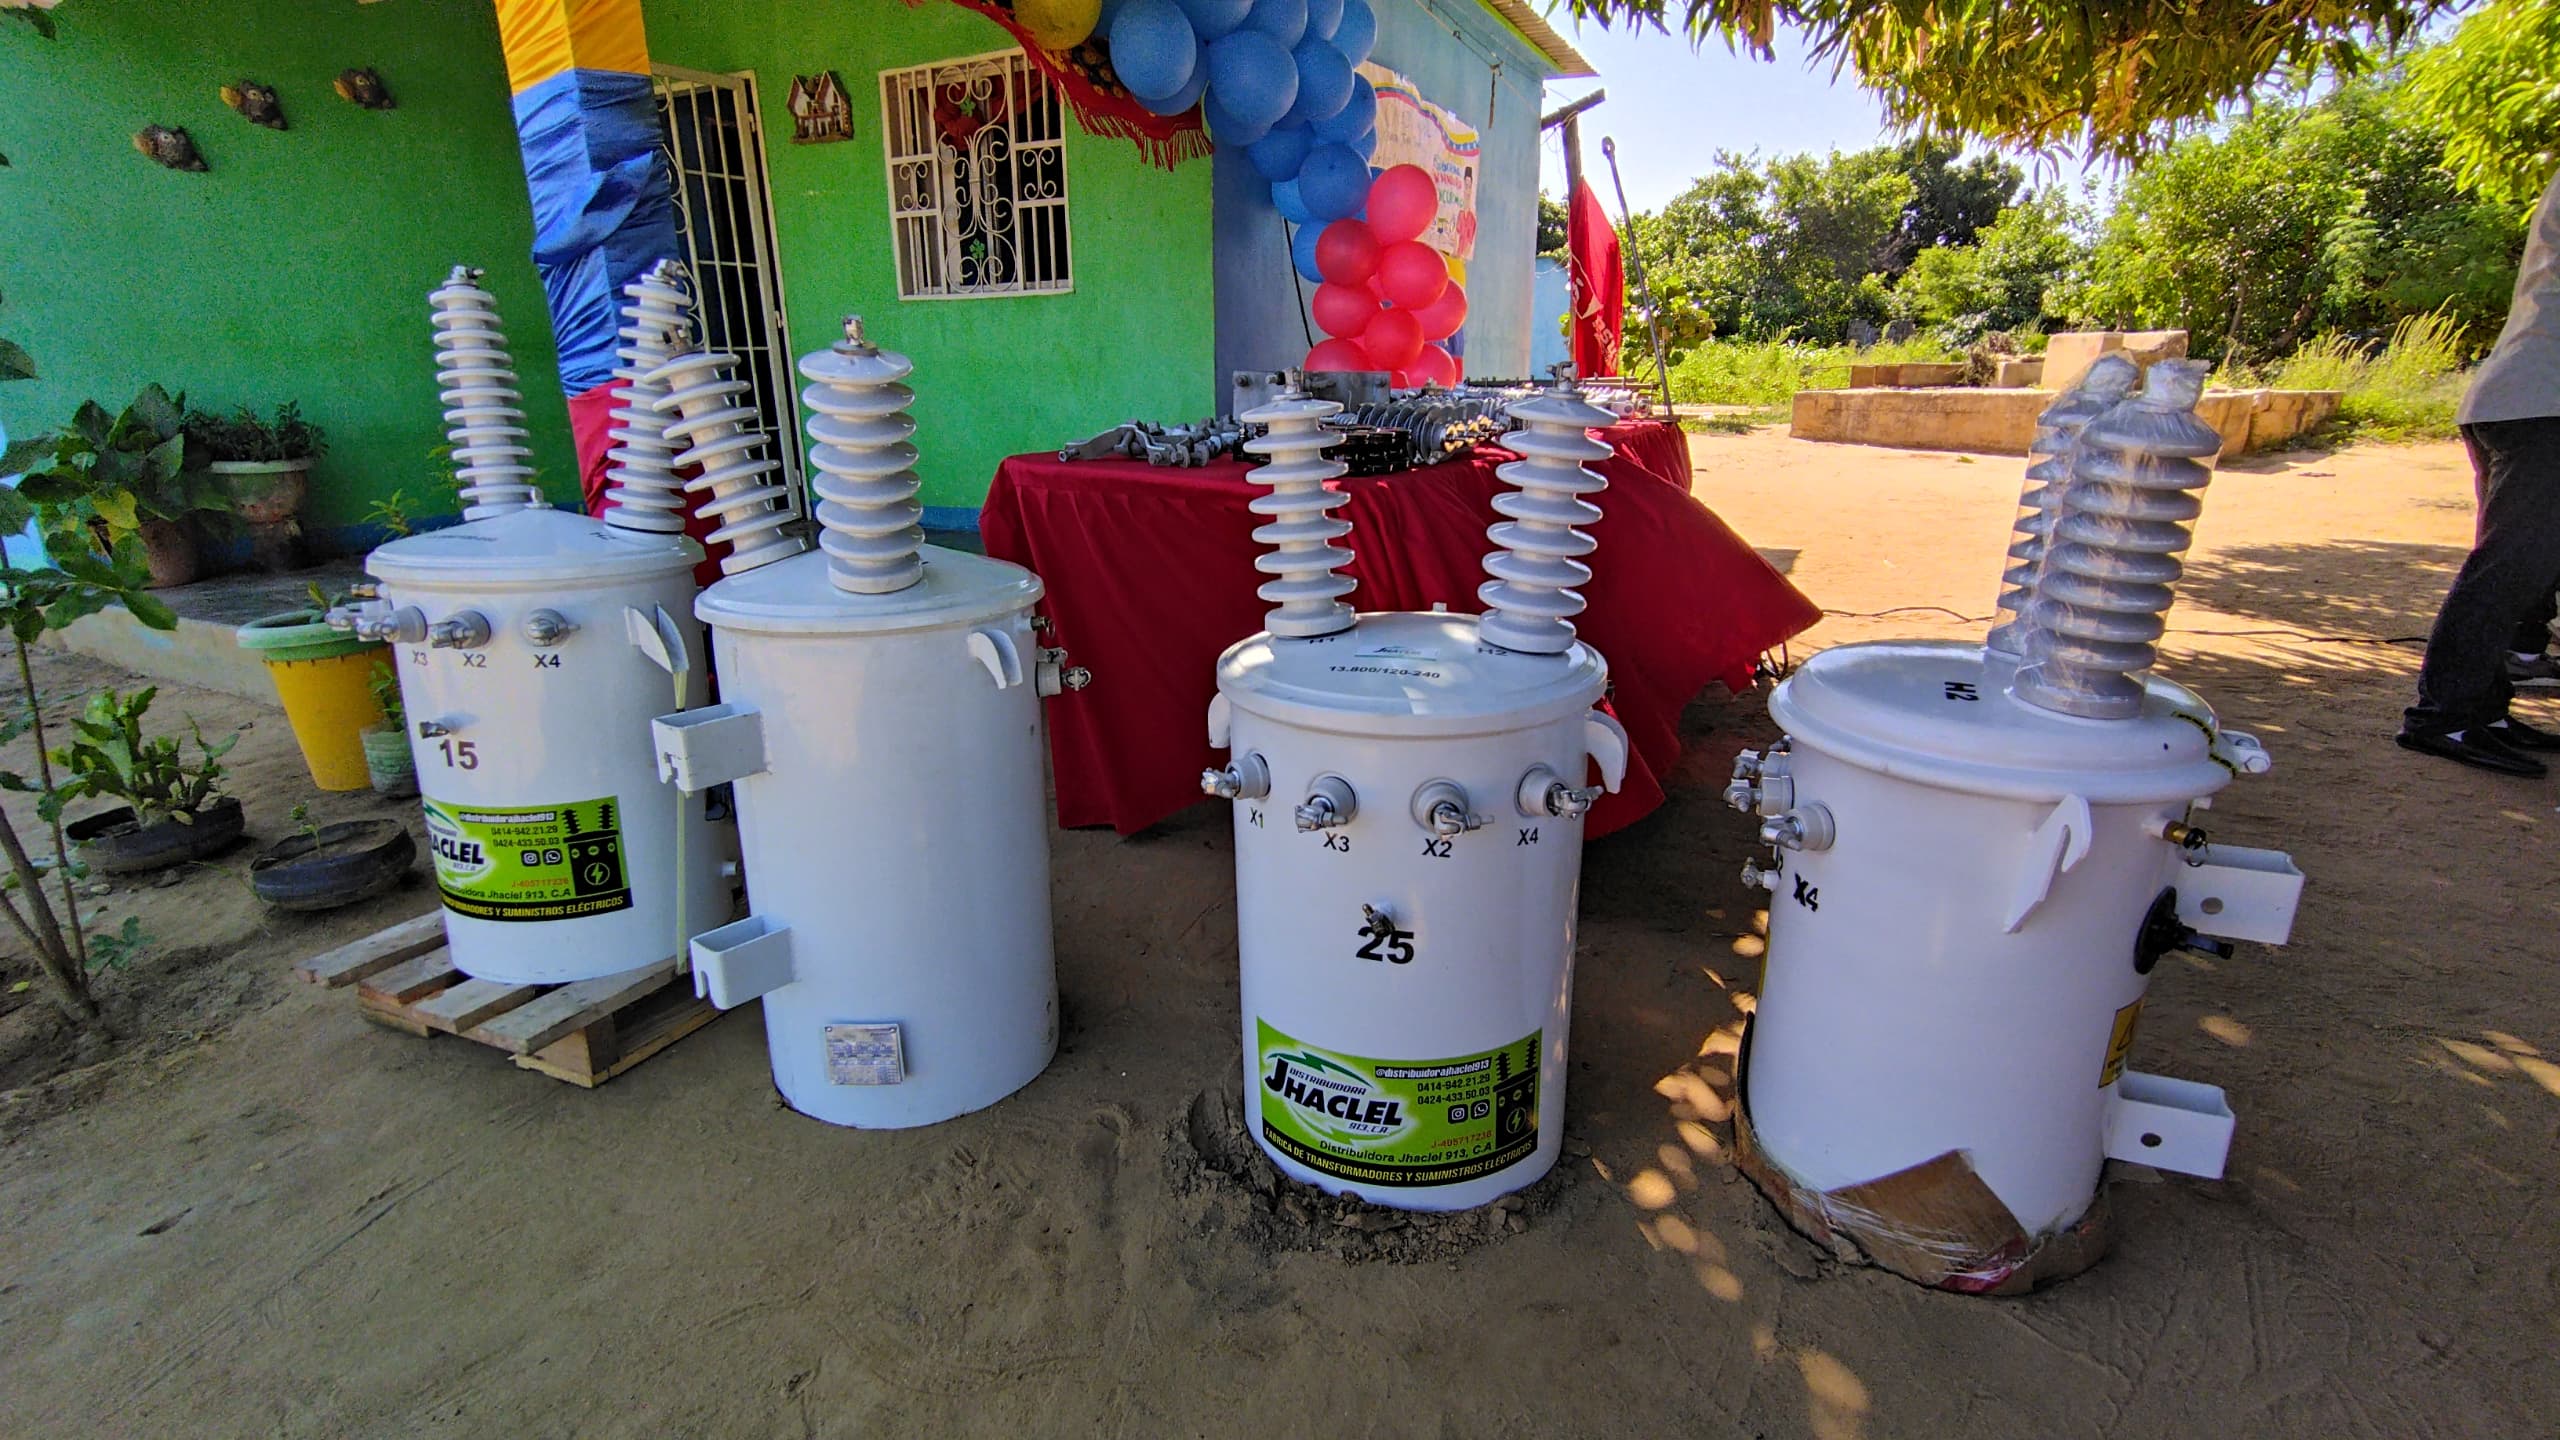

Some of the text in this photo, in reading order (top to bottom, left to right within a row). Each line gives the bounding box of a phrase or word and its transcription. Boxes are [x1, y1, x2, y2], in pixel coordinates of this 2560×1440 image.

[412, 650, 428, 666] X3
[463, 652, 487, 668] X2
[534, 653, 561, 668] X4
[1944, 681, 1979, 701] H2
[439, 739, 479, 770] 15
[1250, 807, 1264, 828] X1
[1323, 831, 1350, 852] X3
[1517, 828, 1539, 846] X4
[431, 834, 484, 865] ACLEL
[1422, 838, 1452, 858] X2
[496, 907, 501, 916] Y
[502, 904, 564, 917] SUMINISTROS
[566, 895, 624, 914] ELÉCTRICOS
[1355, 925, 1415, 964] 25
[1289, 1067, 1367, 1095] DISTRIBUIDORA
[1265, 1058, 1402, 1126] JHACLEL
[1418, 1086, 1490, 1104] 0424-433.50.03
[1319, 1140, 1394, 1162] Distribuidora
[1293, 1146, 1304, 1159] DE
[1306, 1152, 1402, 1182] TRANSFORMADORES
[1406, 1172, 1413, 1181] Y
[1415, 1161, 1482, 1182] SUMINISTROS
